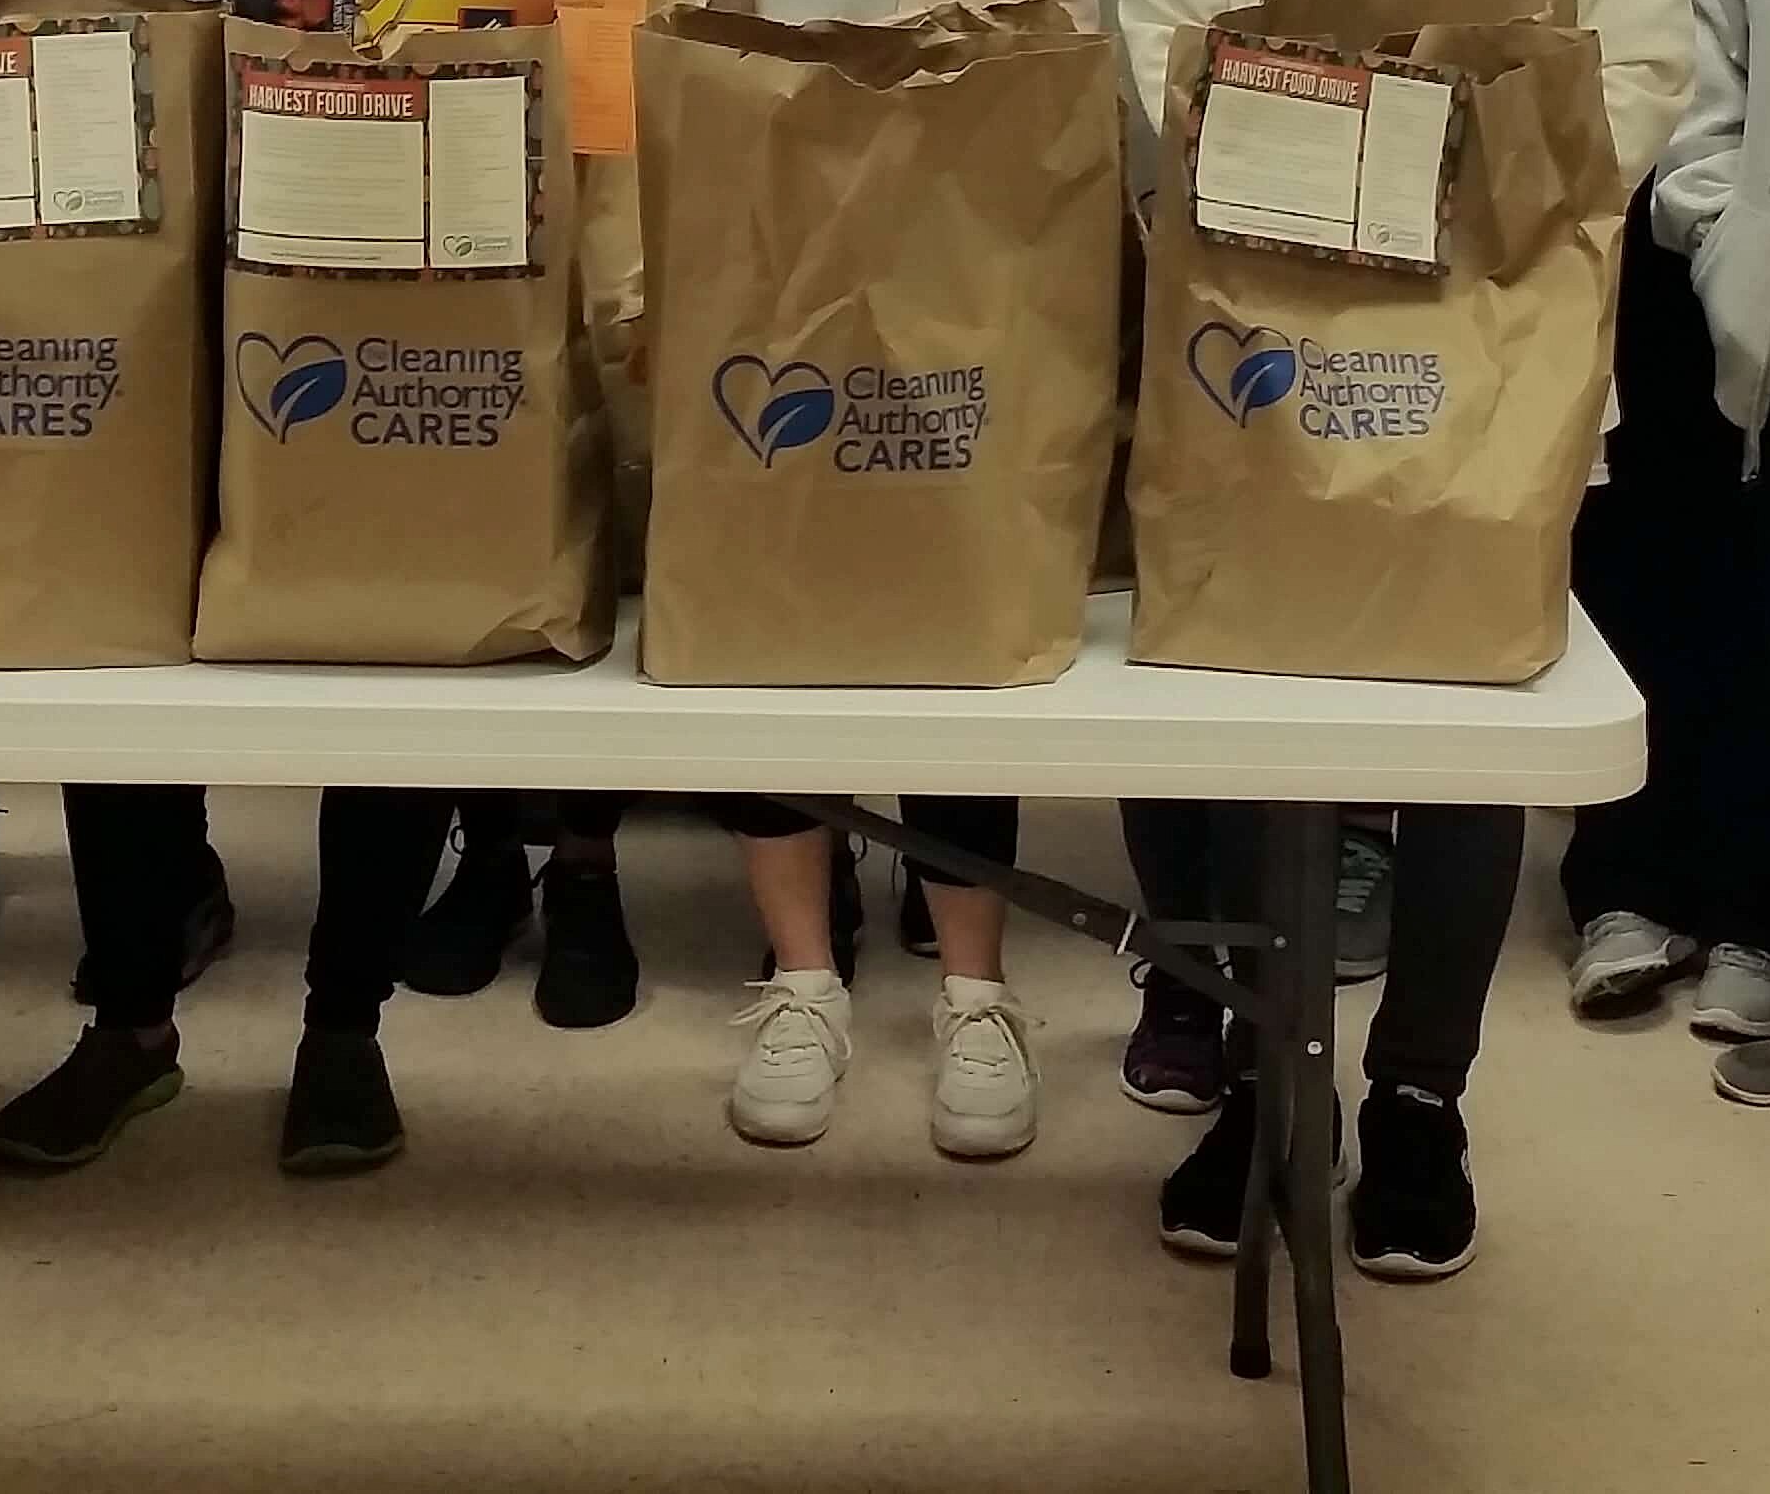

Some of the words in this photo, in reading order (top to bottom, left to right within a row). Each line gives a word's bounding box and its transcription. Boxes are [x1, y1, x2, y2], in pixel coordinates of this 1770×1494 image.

[1221, 58, 1282, 90] HARVEST
[1281, 70, 1317, 97] FOOD
[1318, 76, 1360, 104] DRIVE
[248, 85, 313, 116] HARVEST
[315, 89, 359, 116] FOOD
[362, 92, 414, 118] DRIVE
[355, 337, 524, 382] Cleaning
[1298, 336, 1440, 385] Cleaning
[351, 375, 526, 419] Authority
[842, 364, 985, 402] Cleaning
[1299, 370, 1446, 414] Authority
[350, 413, 500, 448] CARES
[836, 401, 988, 440] Authority
[1298, 403, 1430, 442] CARES
[833, 434, 972, 473] CARES
